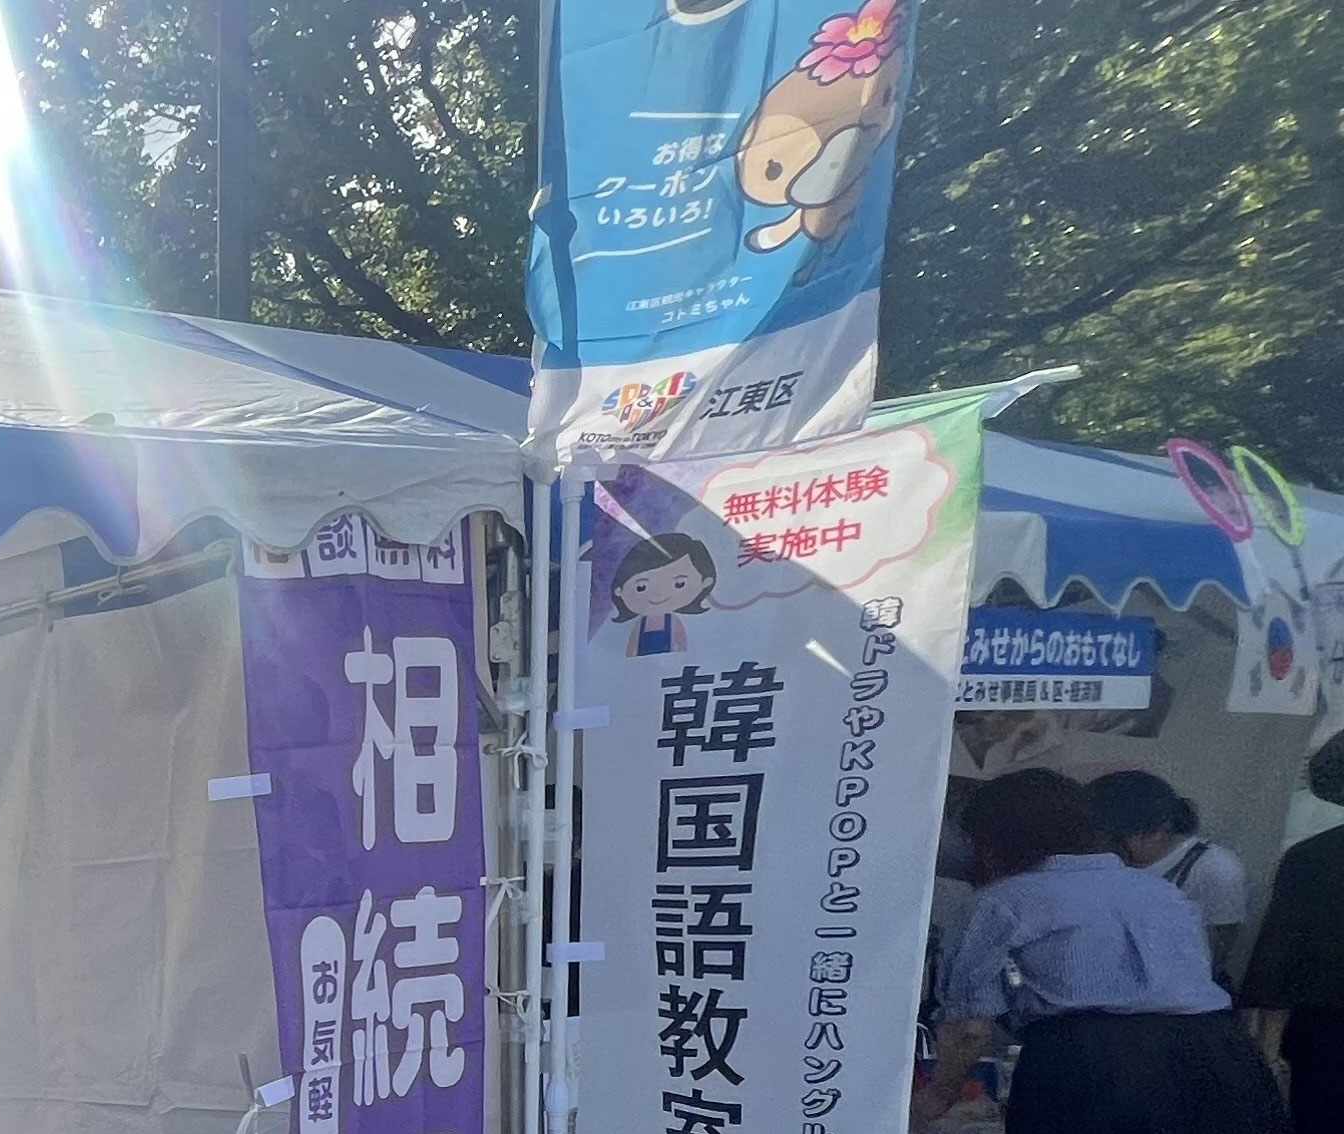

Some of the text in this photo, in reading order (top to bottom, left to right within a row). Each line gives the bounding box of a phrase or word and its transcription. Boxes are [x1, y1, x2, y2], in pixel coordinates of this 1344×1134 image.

[700, 371, 804, 420] 江東区
[722, 465, 890, 527] 無料体験
[737, 519, 862, 568] 実施中
[963, 627, 1141, 668] みせからのおもてなし
